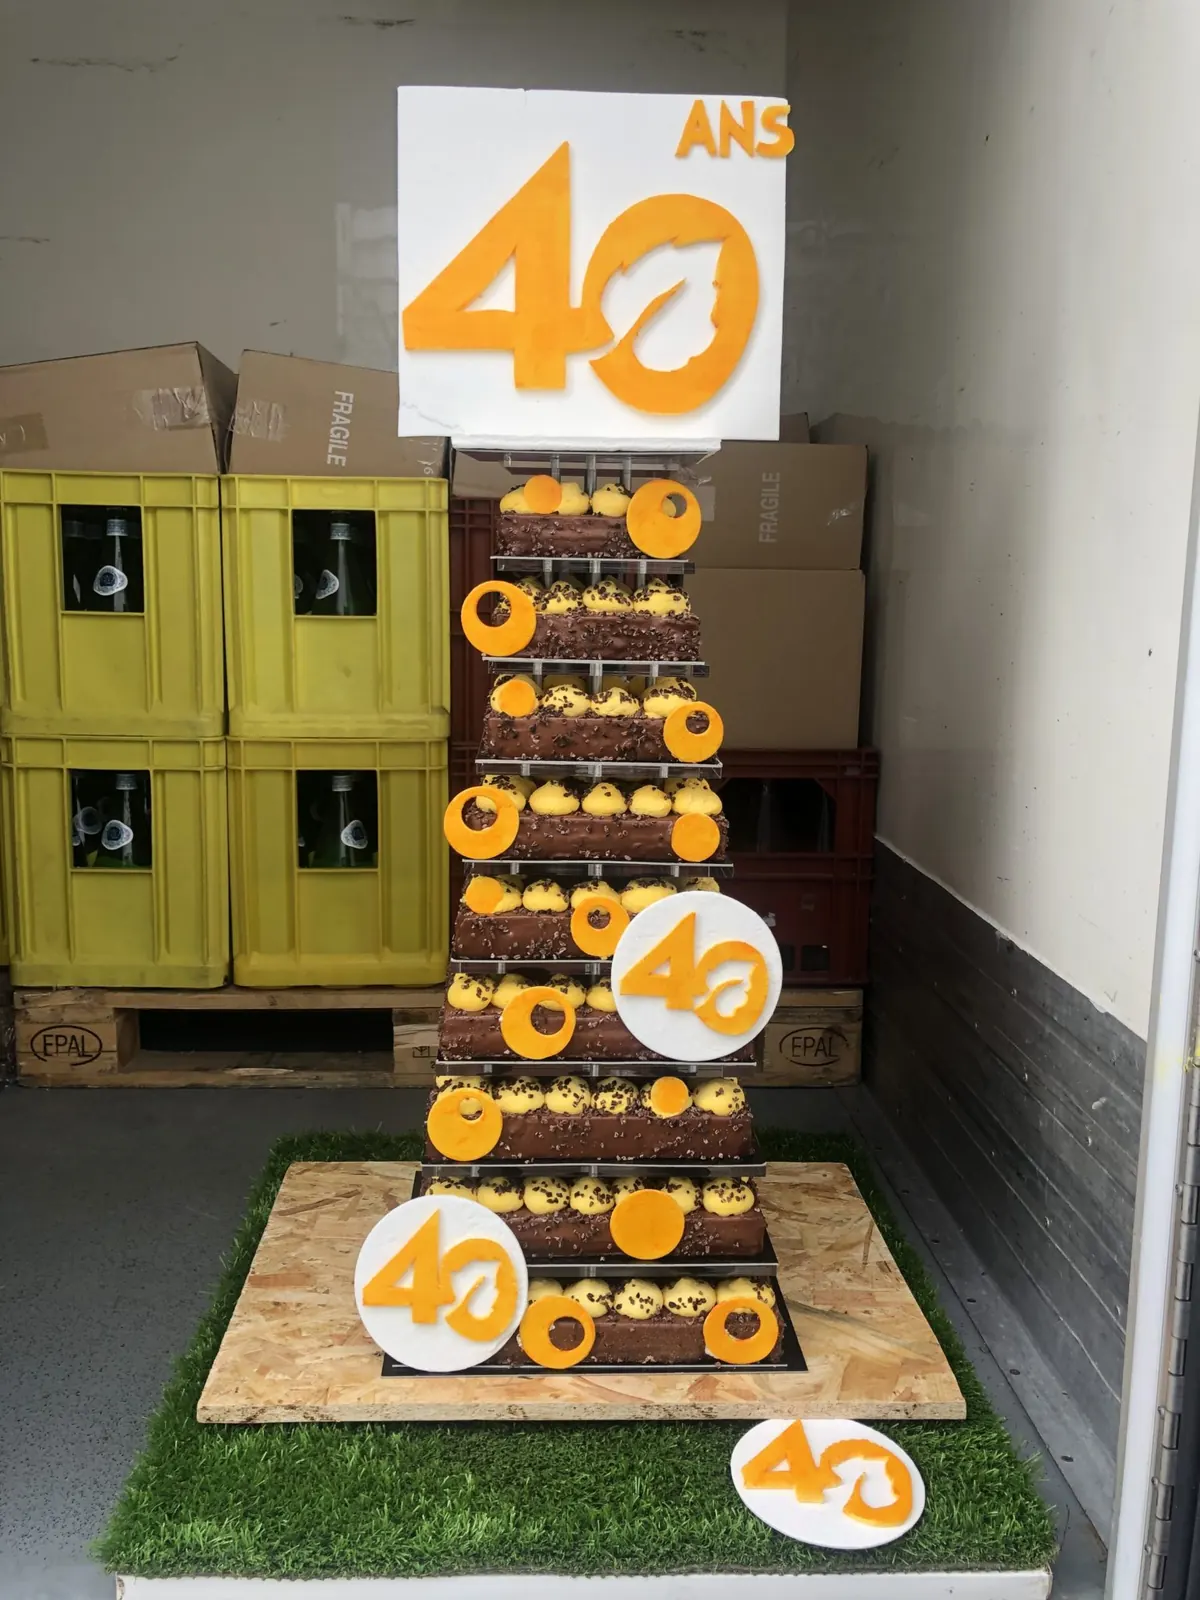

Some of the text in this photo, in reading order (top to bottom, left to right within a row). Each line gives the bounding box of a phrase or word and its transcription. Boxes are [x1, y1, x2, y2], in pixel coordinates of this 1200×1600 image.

[676, 99, 795, 157] ANS
[402, 141, 760, 415] 40
[327, 390, 354, 467] FRAGILE
[759, 472, 780, 543] FRAGILE
[620, 912, 769, 1034] 40
[42, 1034, 94, 1058] EPAL
[791, 1036, 839, 1058] EPAL
[363, 1209, 518, 1341] 40
[741, 1419, 913, 1525] 40
